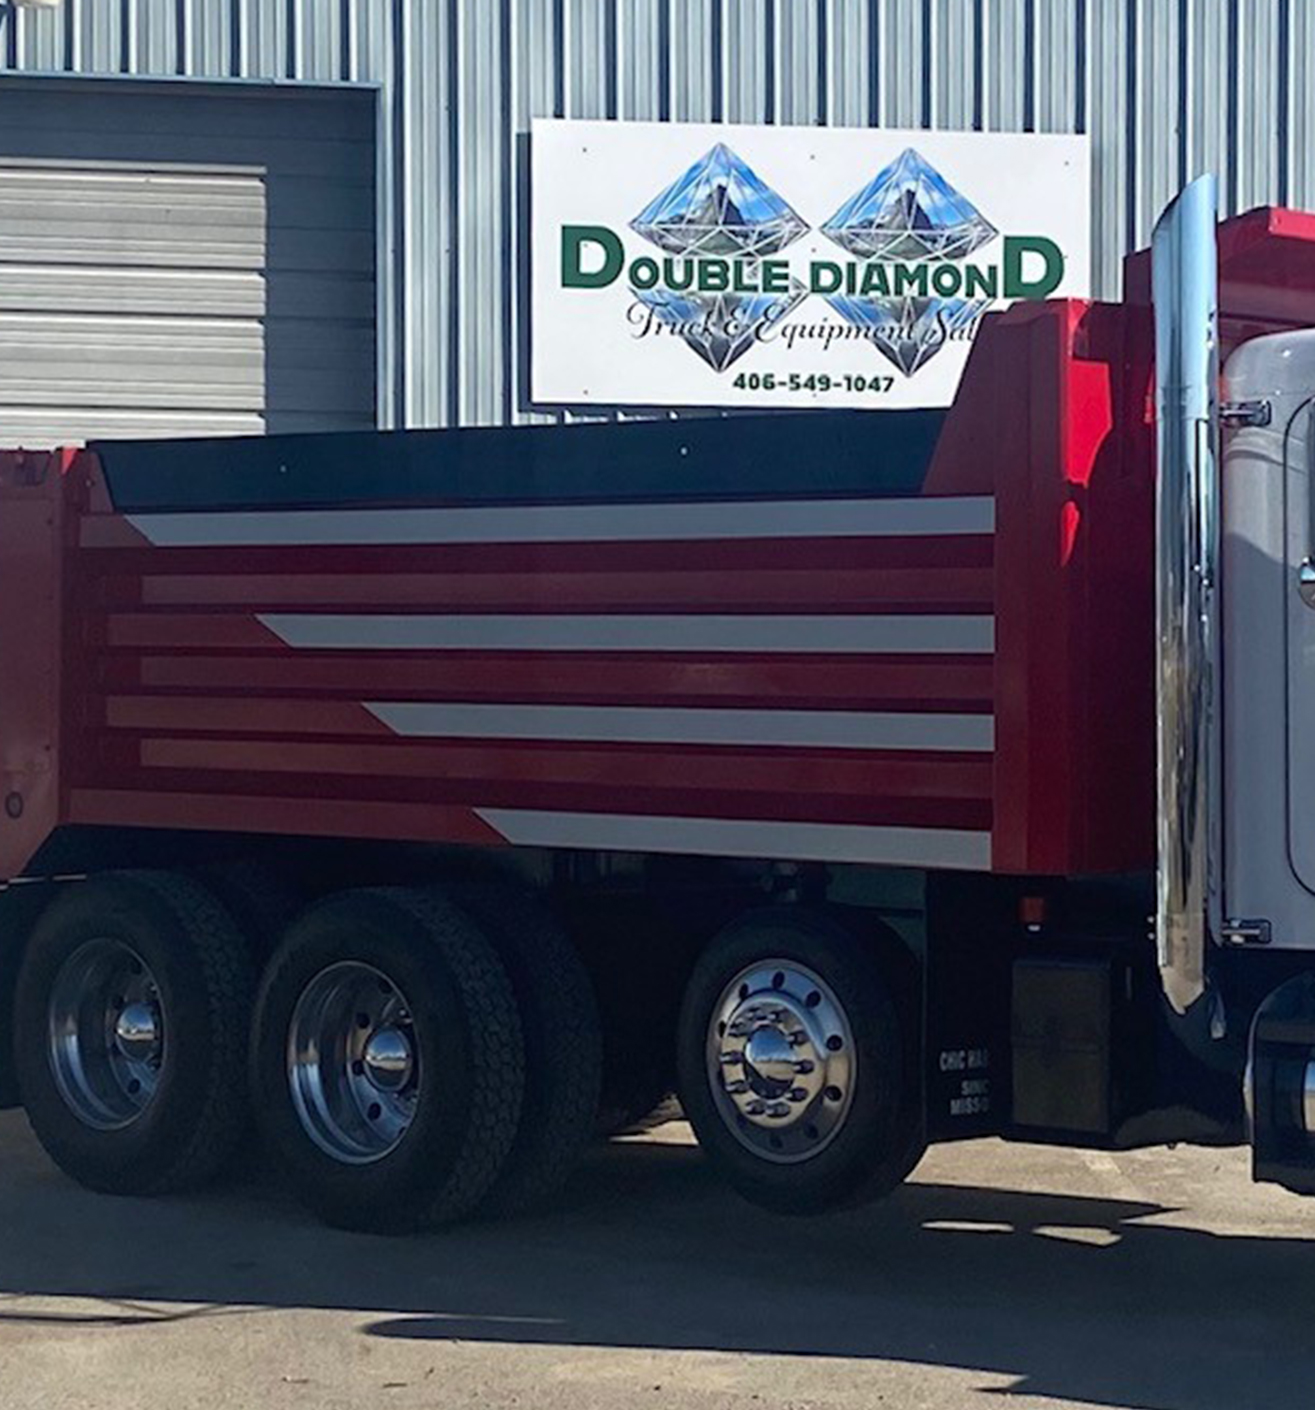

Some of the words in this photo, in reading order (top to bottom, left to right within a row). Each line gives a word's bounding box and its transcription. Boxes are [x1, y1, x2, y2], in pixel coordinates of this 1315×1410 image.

[561, 225, 790, 293] DOUBLE
[809, 235, 1065, 299] DIAMOND
[626, 301, 721, 340] Truck
[723, 315, 743, 338] &
[754, 304, 917, 350] Equipment
[922, 305, 979, 345] Sal
[733, 372, 895, 392] 406-549-1047
[950, 1096, 990, 1115] MISSO
